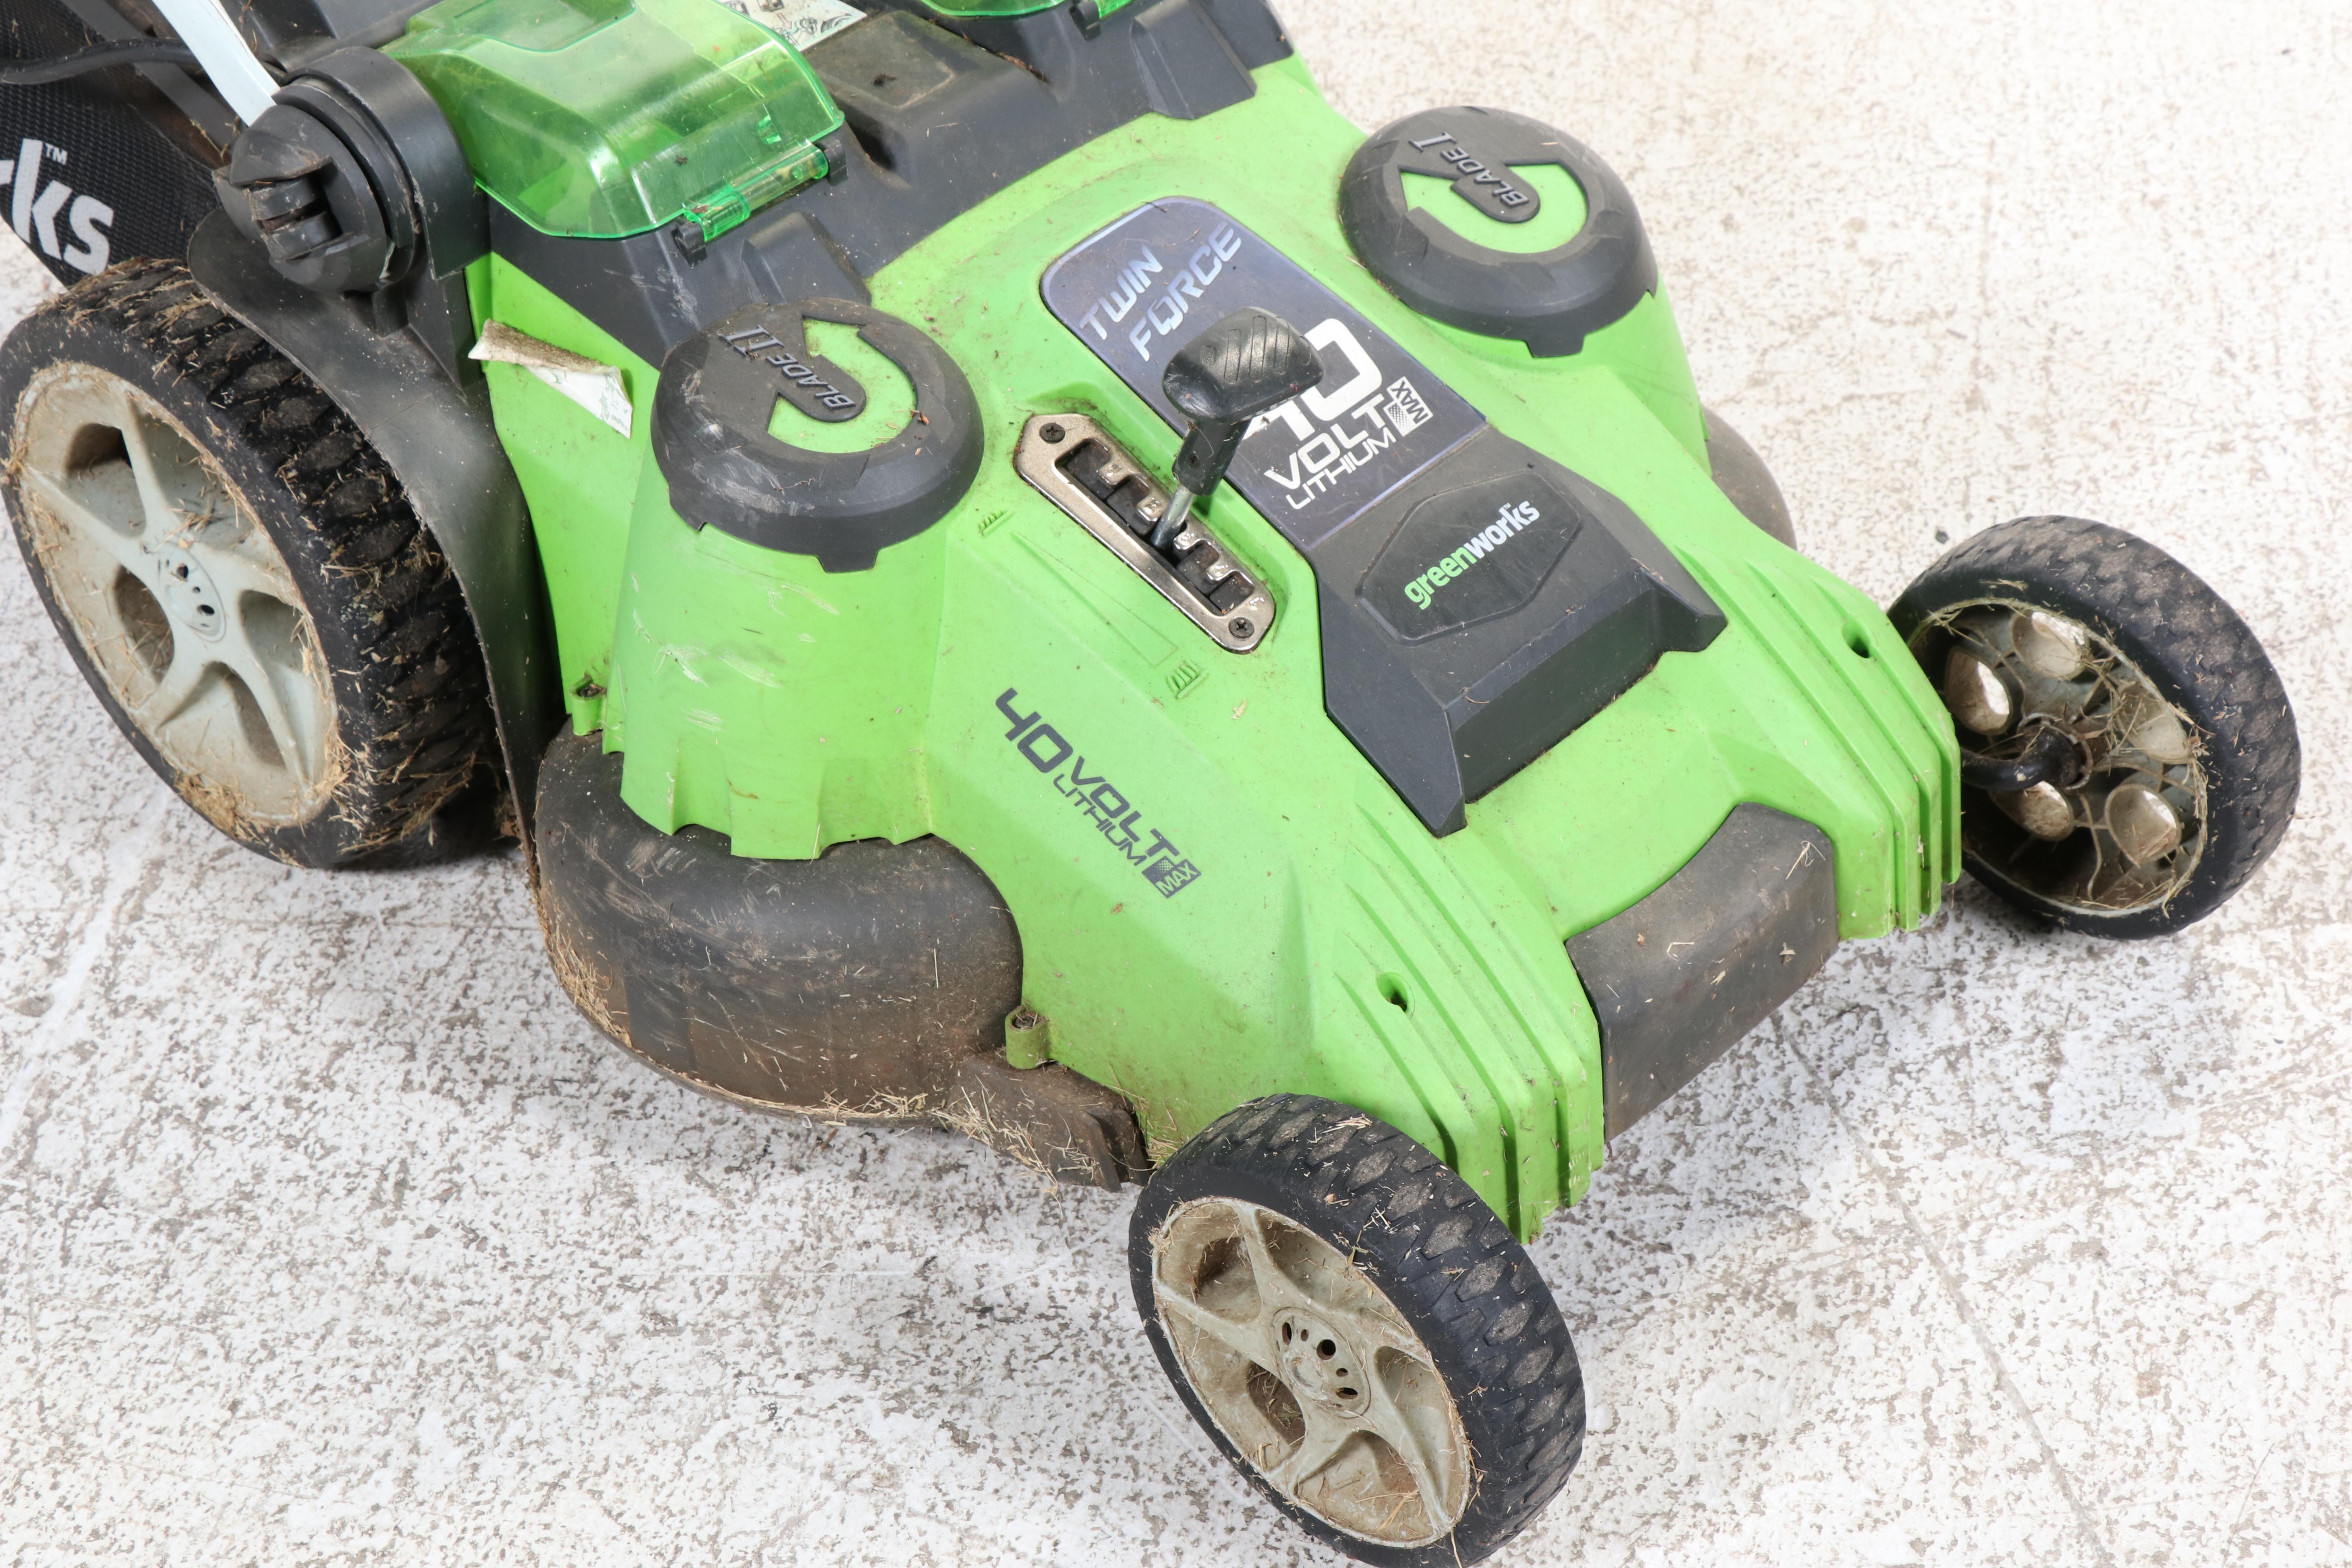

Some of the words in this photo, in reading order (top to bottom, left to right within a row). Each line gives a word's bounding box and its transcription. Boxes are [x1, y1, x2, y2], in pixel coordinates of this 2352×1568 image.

[0, 138, 114, 275] ks
[1440, 146, 1530, 208] BLADE
[1079, 245, 1163, 341] TWIN
[1128, 222, 1242, 362] FORCE
[766, 353, 857, 409] BLADE
[1390, 380, 1428, 425] MAX
[1263, 393, 1386, 490] VOLT
[1286, 426, 1397, 510] LITHIUM
[1404, 500, 1540, 610] greenworks
[995, 687, 1073, 773] 40
[1071, 755, 1180, 858] VOLT
[1053, 773, 1147, 866] LITHIUM
[1155, 860, 1198, 897] MAX
